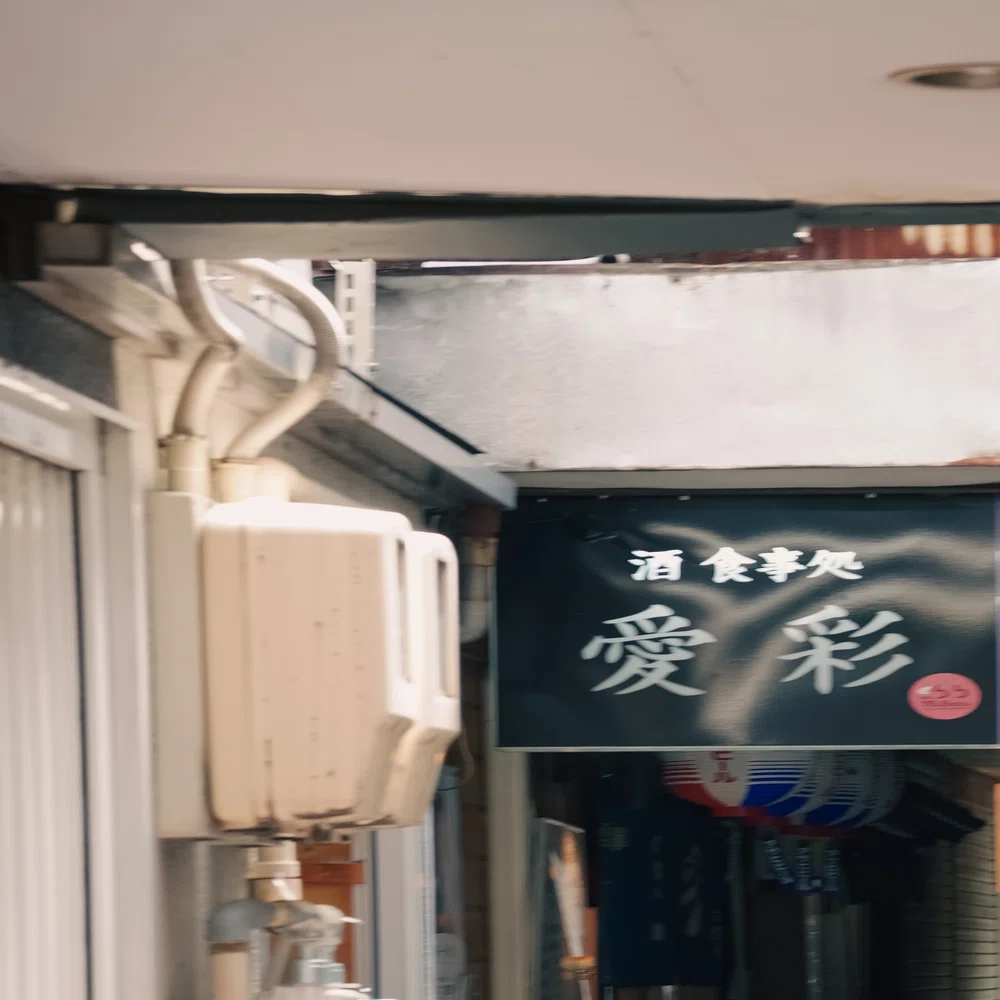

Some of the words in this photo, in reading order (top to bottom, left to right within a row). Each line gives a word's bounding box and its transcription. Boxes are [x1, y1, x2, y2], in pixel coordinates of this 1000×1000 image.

[628, 549, 684, 582] 酒
[699, 546, 864, 583] 食事処
